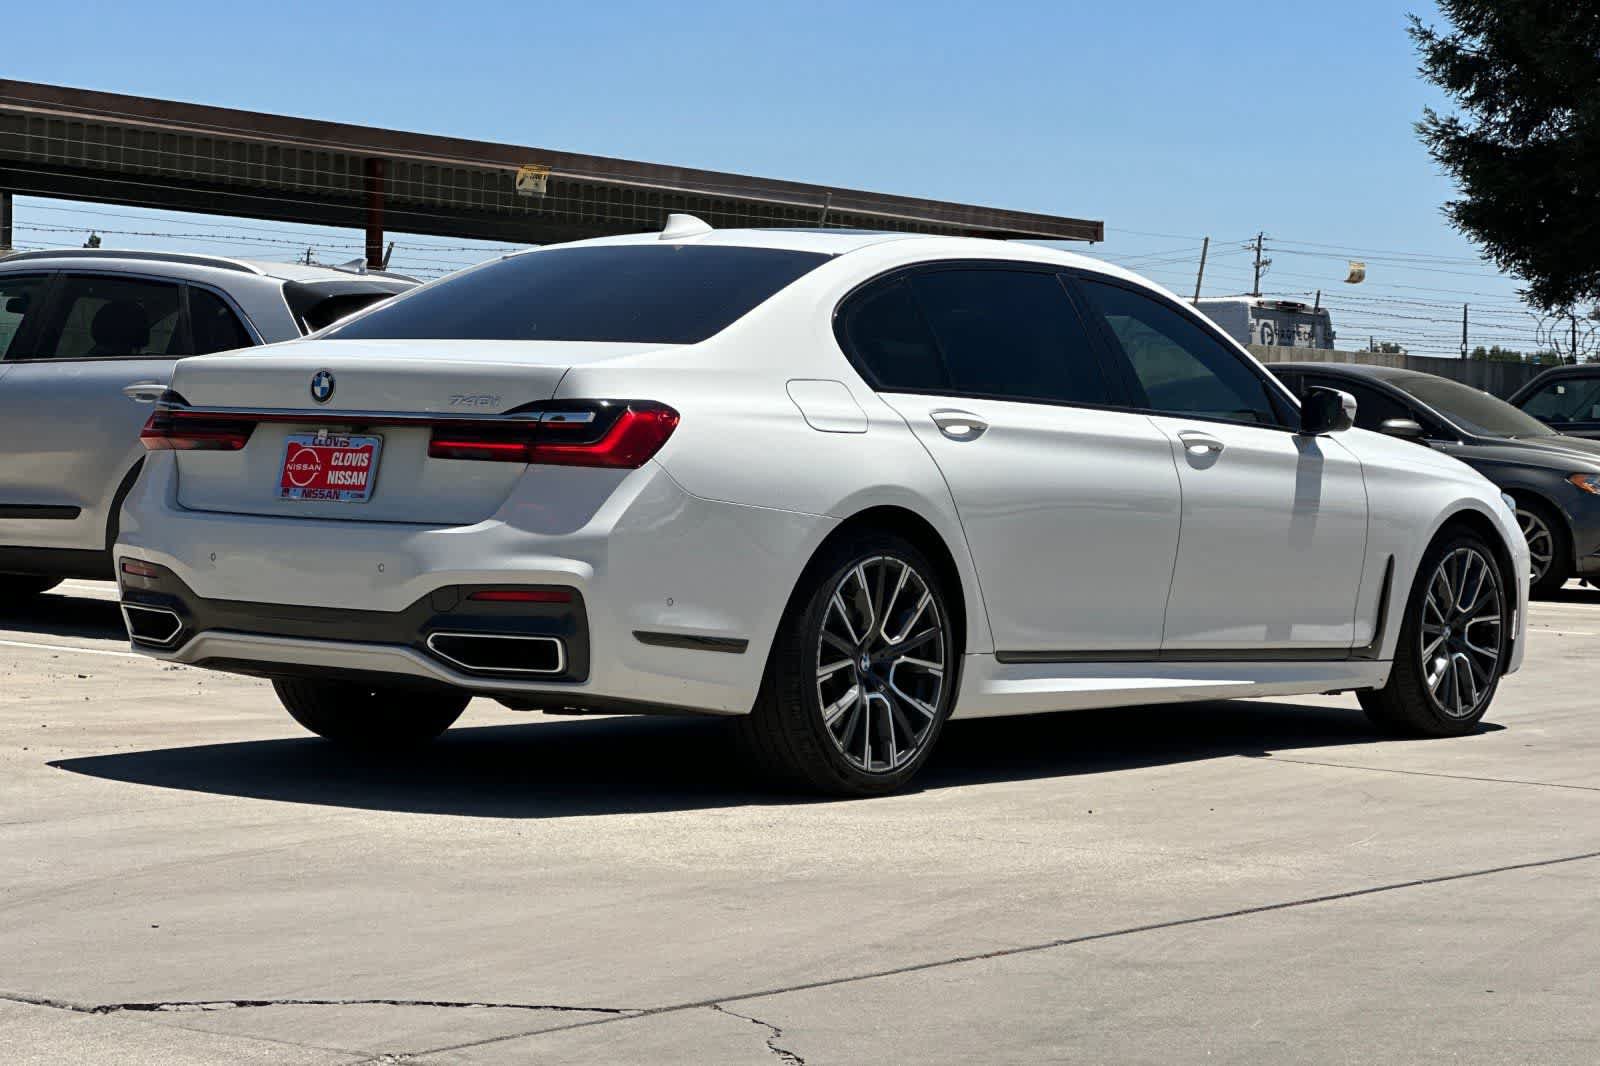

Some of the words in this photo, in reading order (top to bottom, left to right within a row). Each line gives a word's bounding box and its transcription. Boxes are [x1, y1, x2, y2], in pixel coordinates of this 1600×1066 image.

[331, 452, 369, 466] CLOVIS
[327, 471, 367, 485] NISSAN
[301, 489, 340, 499] NISSAN
